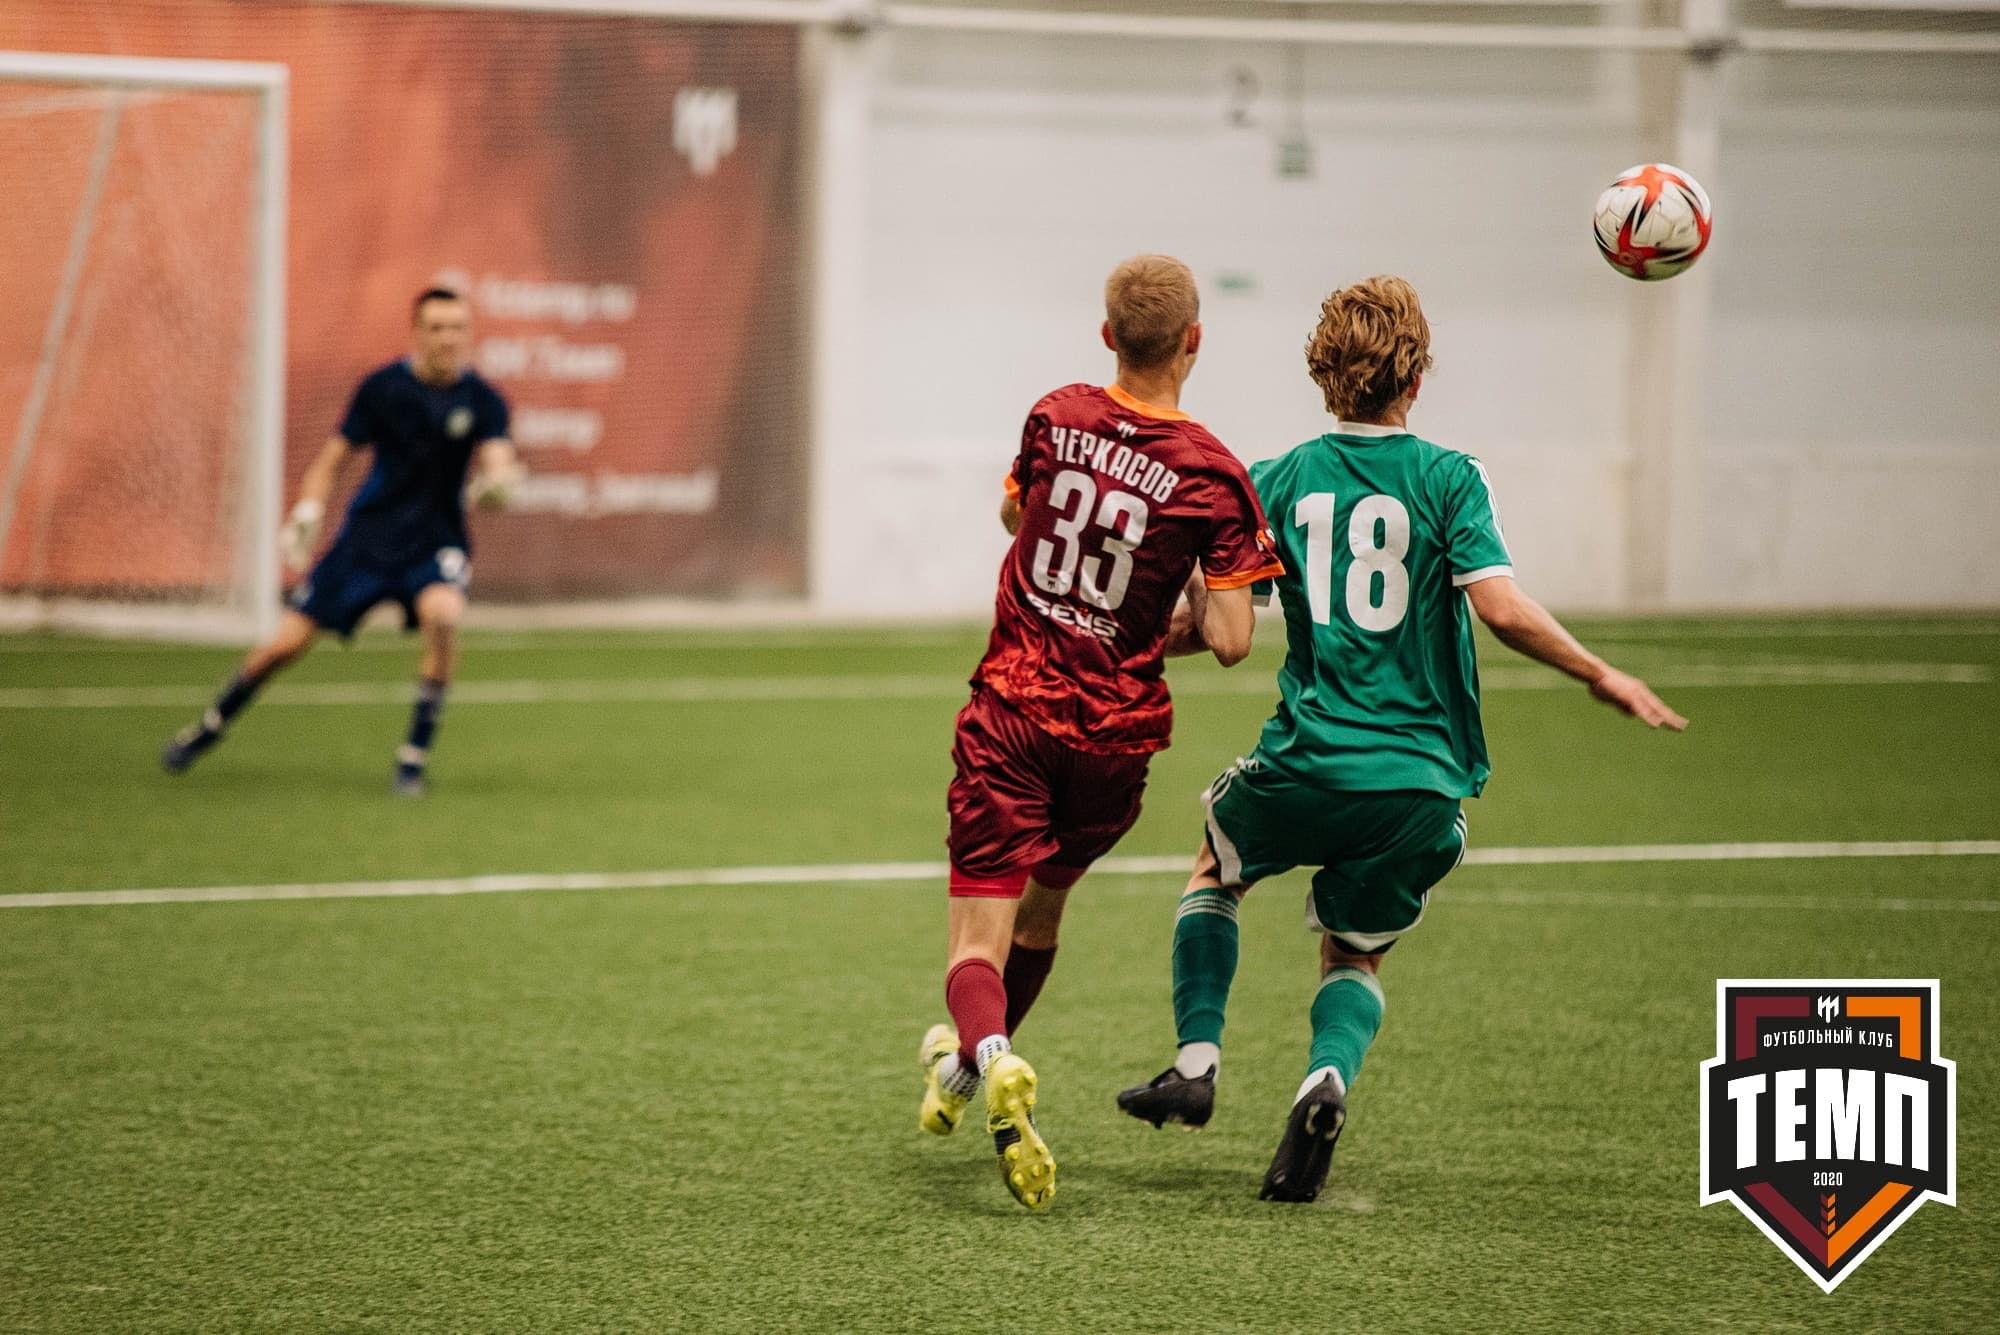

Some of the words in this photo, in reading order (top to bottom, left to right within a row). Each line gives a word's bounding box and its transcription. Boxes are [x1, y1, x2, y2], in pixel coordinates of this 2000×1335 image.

[1051, 426, 1180, 504] ЧЕРКАСОВ
[1032, 469, 1149, 610] 33
[1295, 492, 1410, 632] 18
